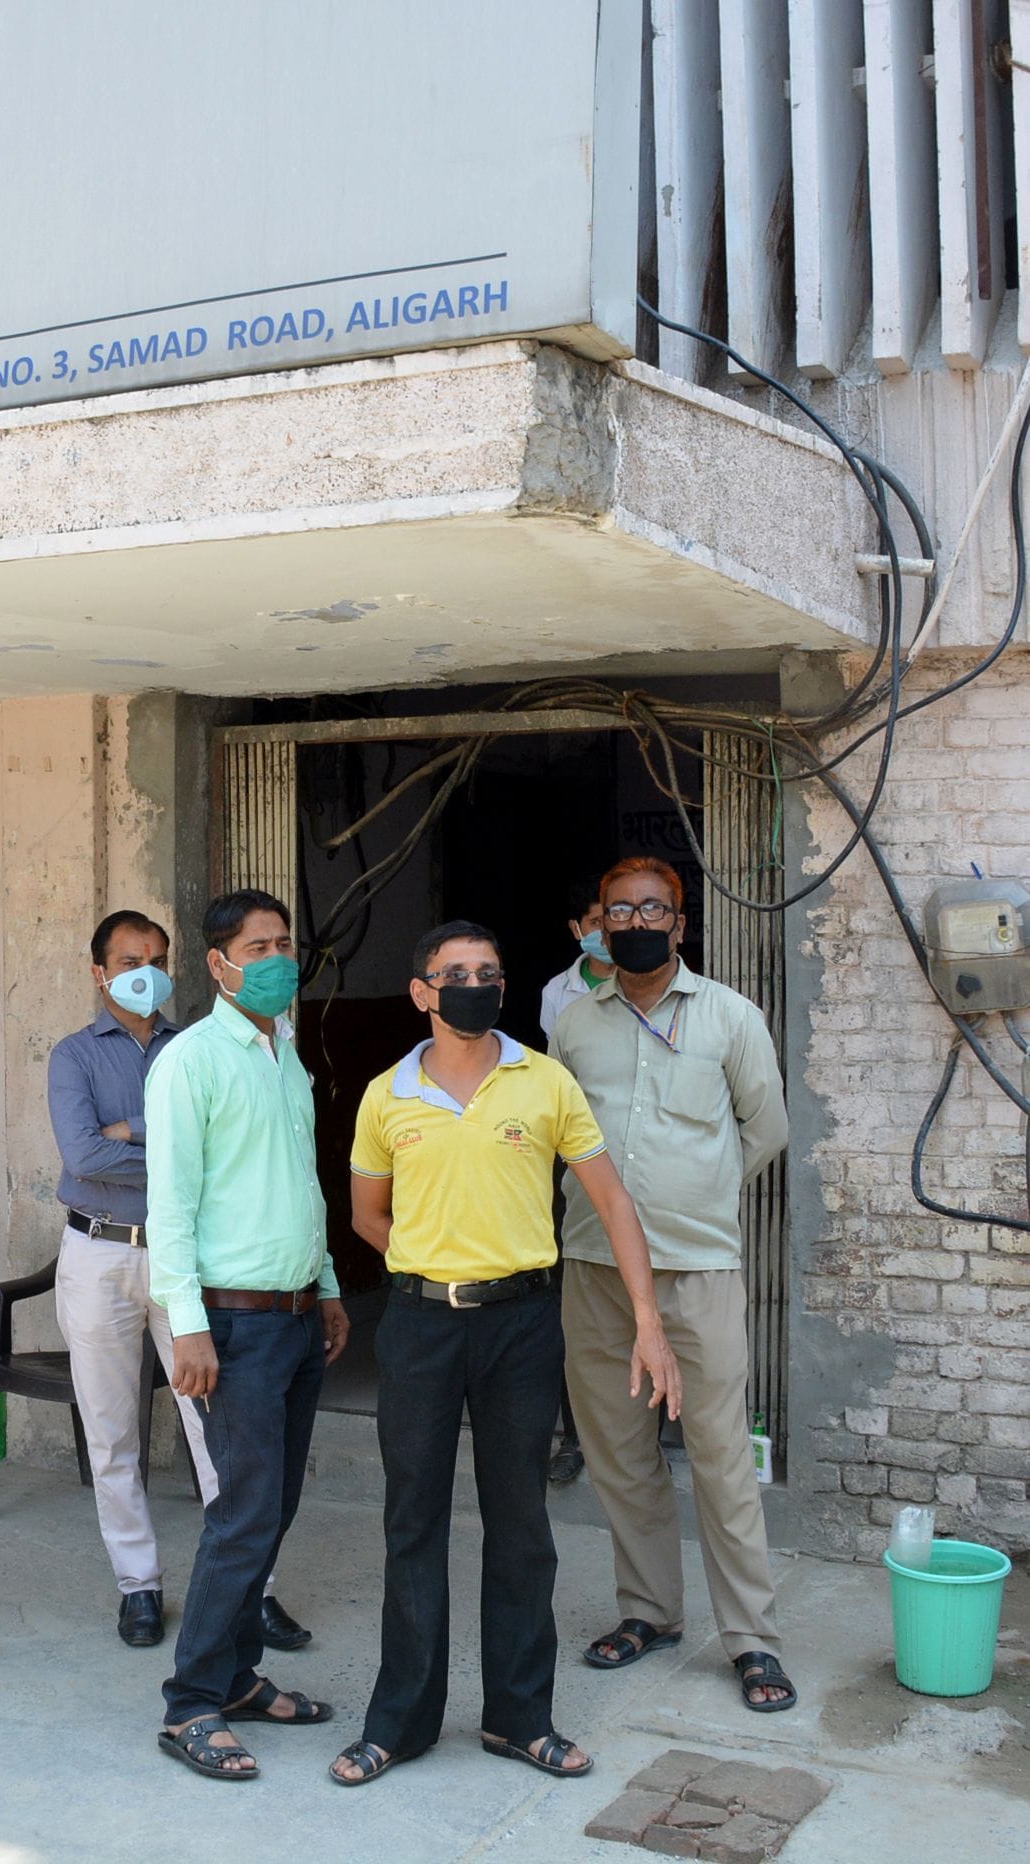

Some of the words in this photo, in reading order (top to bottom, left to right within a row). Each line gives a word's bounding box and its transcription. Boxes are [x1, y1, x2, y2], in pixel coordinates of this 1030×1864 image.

[51, 350, 78, 384] 3,
[87, 327, 207, 374] SAMAD
[227, 308, 334, 352] ROAD,
[346, 280, 508, 333] ALIGARH
